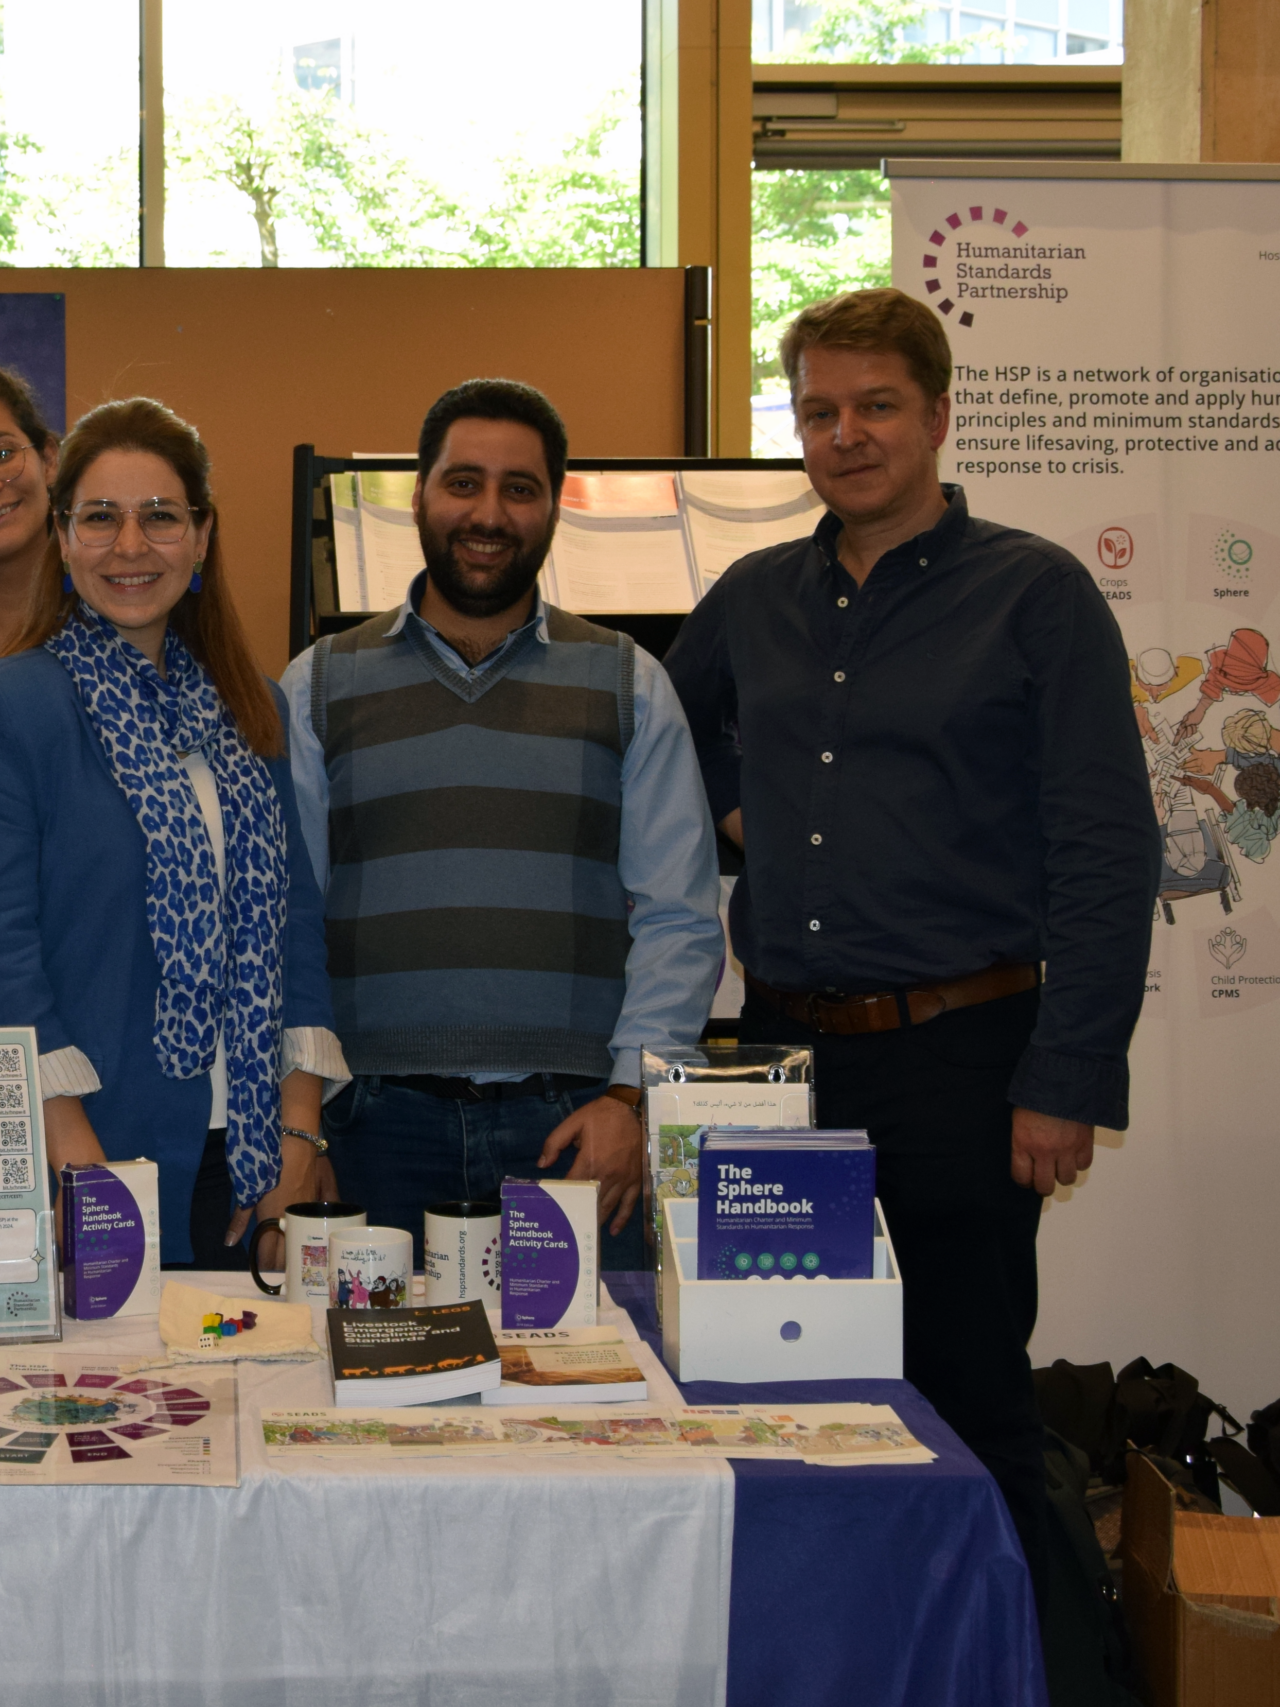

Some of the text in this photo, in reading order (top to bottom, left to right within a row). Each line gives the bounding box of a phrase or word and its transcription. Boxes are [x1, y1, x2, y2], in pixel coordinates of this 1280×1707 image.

[956, 242, 1086, 259] Humanitarian
[956, 263, 1052, 280] Standards
[957, 283, 1068, 303] Partnership
[955, 366, 989, 382] The
[995, 366, 1031, 382] HSP
[1037, 366, 1051, 382] is
[1057, 370, 1067, 382] a
[1073, 366, 1150, 383] network
[1156, 366, 1175, 383] of
[955, 389, 993, 405] that
[999, 389, 1063, 407] define,
[1069, 390, 1149, 409] promote
[1155, 389, 1189, 405] and
[1195, 389, 1246, 410] apply
[956, 412, 1280, 432] principles and minimum standards
[956, 437, 1020, 451] ensure
[1026, 435, 1119, 455] lifesaving,
[1125, 436, 1219, 455] protective
[1224, 435, 1258, 451] and
[956, 457, 1124, 478] response to crisis.
[1099, 578, 1128, 589] Crops
[1213, 588, 1250, 598] Sphere
[1211, 975, 1236, 985] Child
[1211, 989, 1240, 998] CPMS
[717, 1164, 752, 1179] The
[717, 1180, 784, 1200] Sphere
[82, 1195, 97, 1204] The
[82, 1203, 109, 1214] Sphere
[716, 1198, 814, 1214] Handbook
[82, 1211, 122, 1222] Handbook
[509, 1210, 525, 1219] The
[82, 1219, 135, 1232] Activity Cards
[509, 1219, 539, 1230] Sphere
[509, 1229, 554, 1239] Handbook
[509, 1238, 569, 1249] Activity Cards
[458, 1230, 467, 1299] hspstandards.org
[432, 1306, 472, 1316] LEGS
[342, 1320, 418, 1328] Livestock
[343, 1326, 432, 1334] Emergency
[343, 1326, 461, 1339] Guidelines and
[502, 1331, 570, 1339] SEADS
[344, 1336, 426, 1344] Standards
